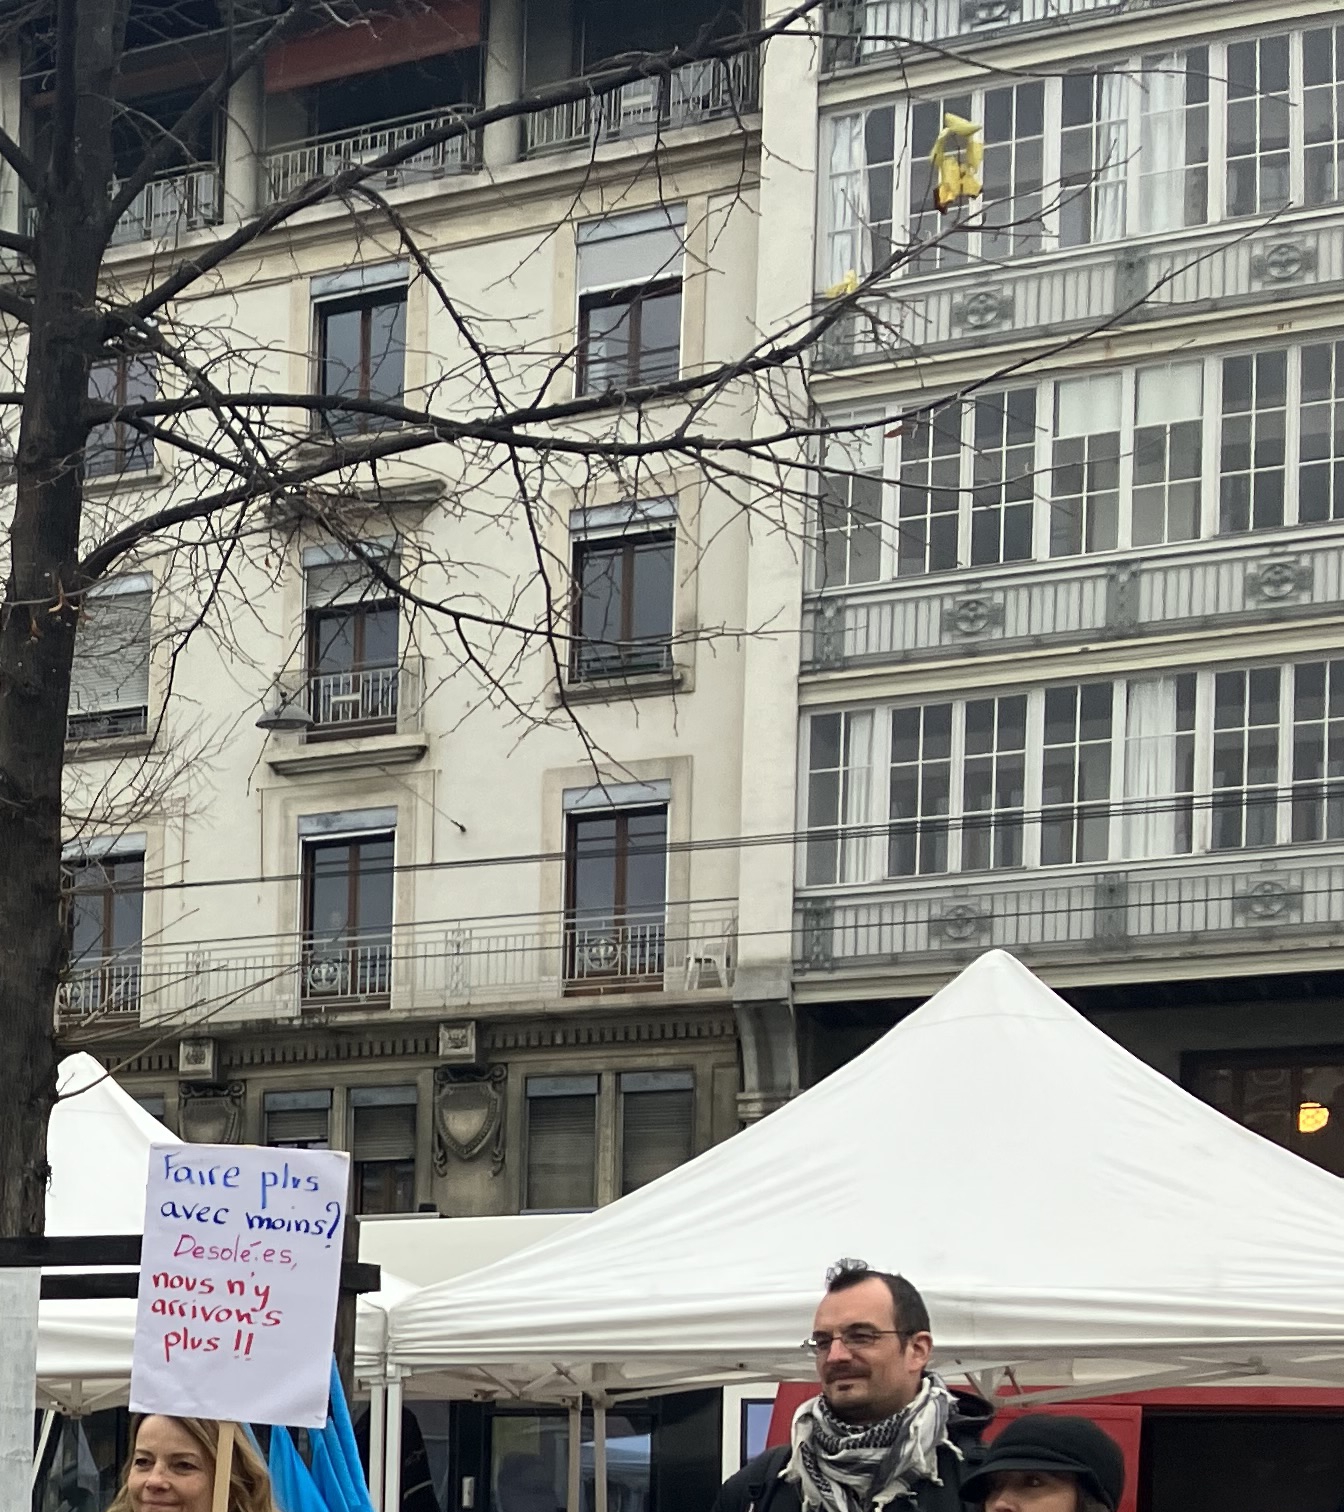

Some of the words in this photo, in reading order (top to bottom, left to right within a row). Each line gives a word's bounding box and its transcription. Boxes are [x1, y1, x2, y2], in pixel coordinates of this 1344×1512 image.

[164, 1151, 241, 1189] Faire
[261, 1162, 320, 1210] plus
[160, 1200, 230, 1225] avec
[152, 1271, 216, 1295] nous
[226, 1271, 271, 1312] n'y
[151, 1298, 283, 1327] arrivons
[163, 1326, 221, 1363] plus
